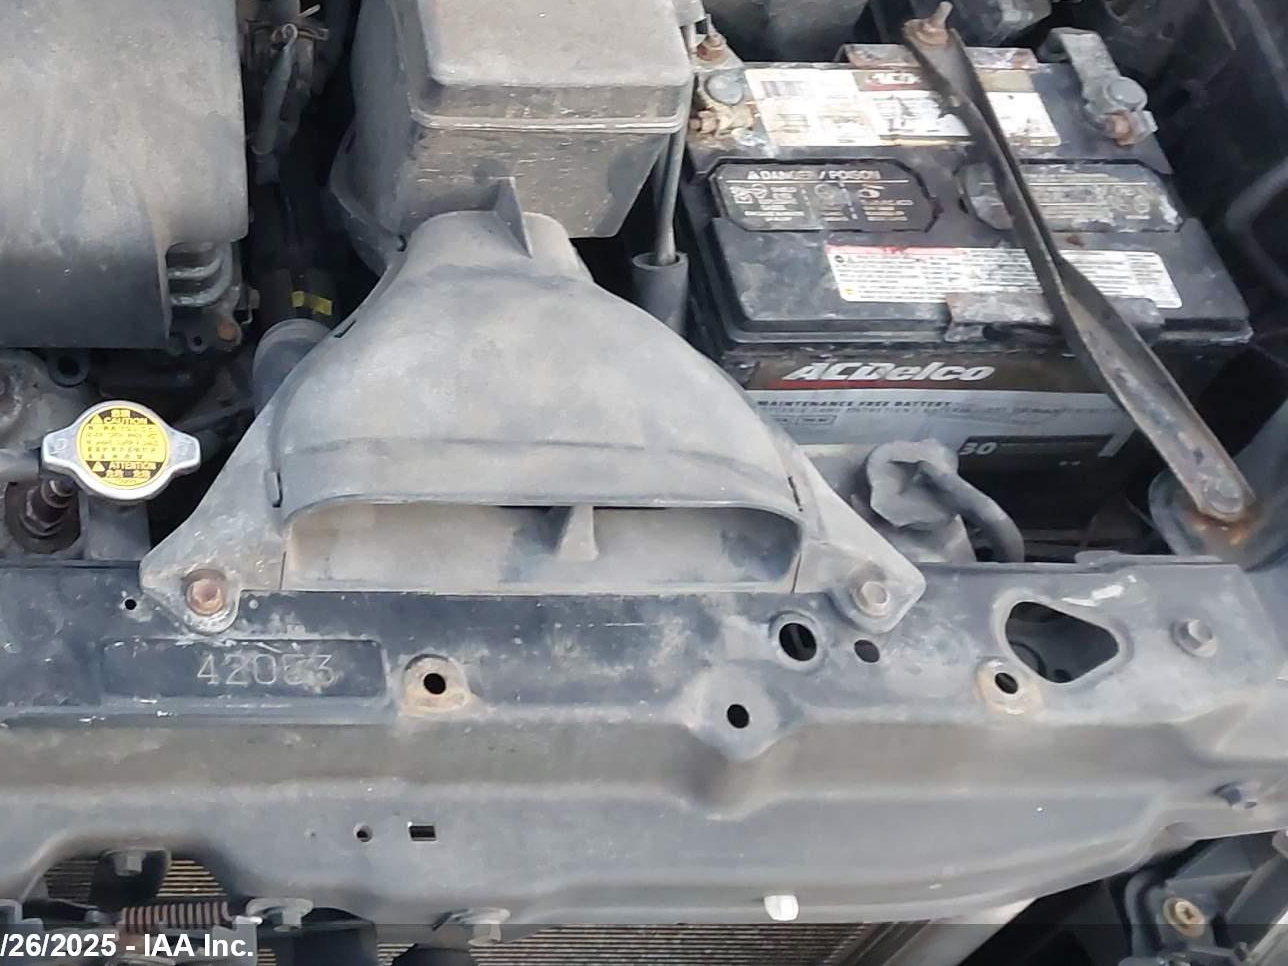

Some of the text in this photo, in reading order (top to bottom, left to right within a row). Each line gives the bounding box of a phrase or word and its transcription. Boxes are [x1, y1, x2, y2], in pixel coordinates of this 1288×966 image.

[781, 361, 996, 382] ACDelco
[893, 400, 953, 408] BATTERY
[103, 417, 148, 425] CAUTION
[108, 461, 157, 470] ATTENTION
